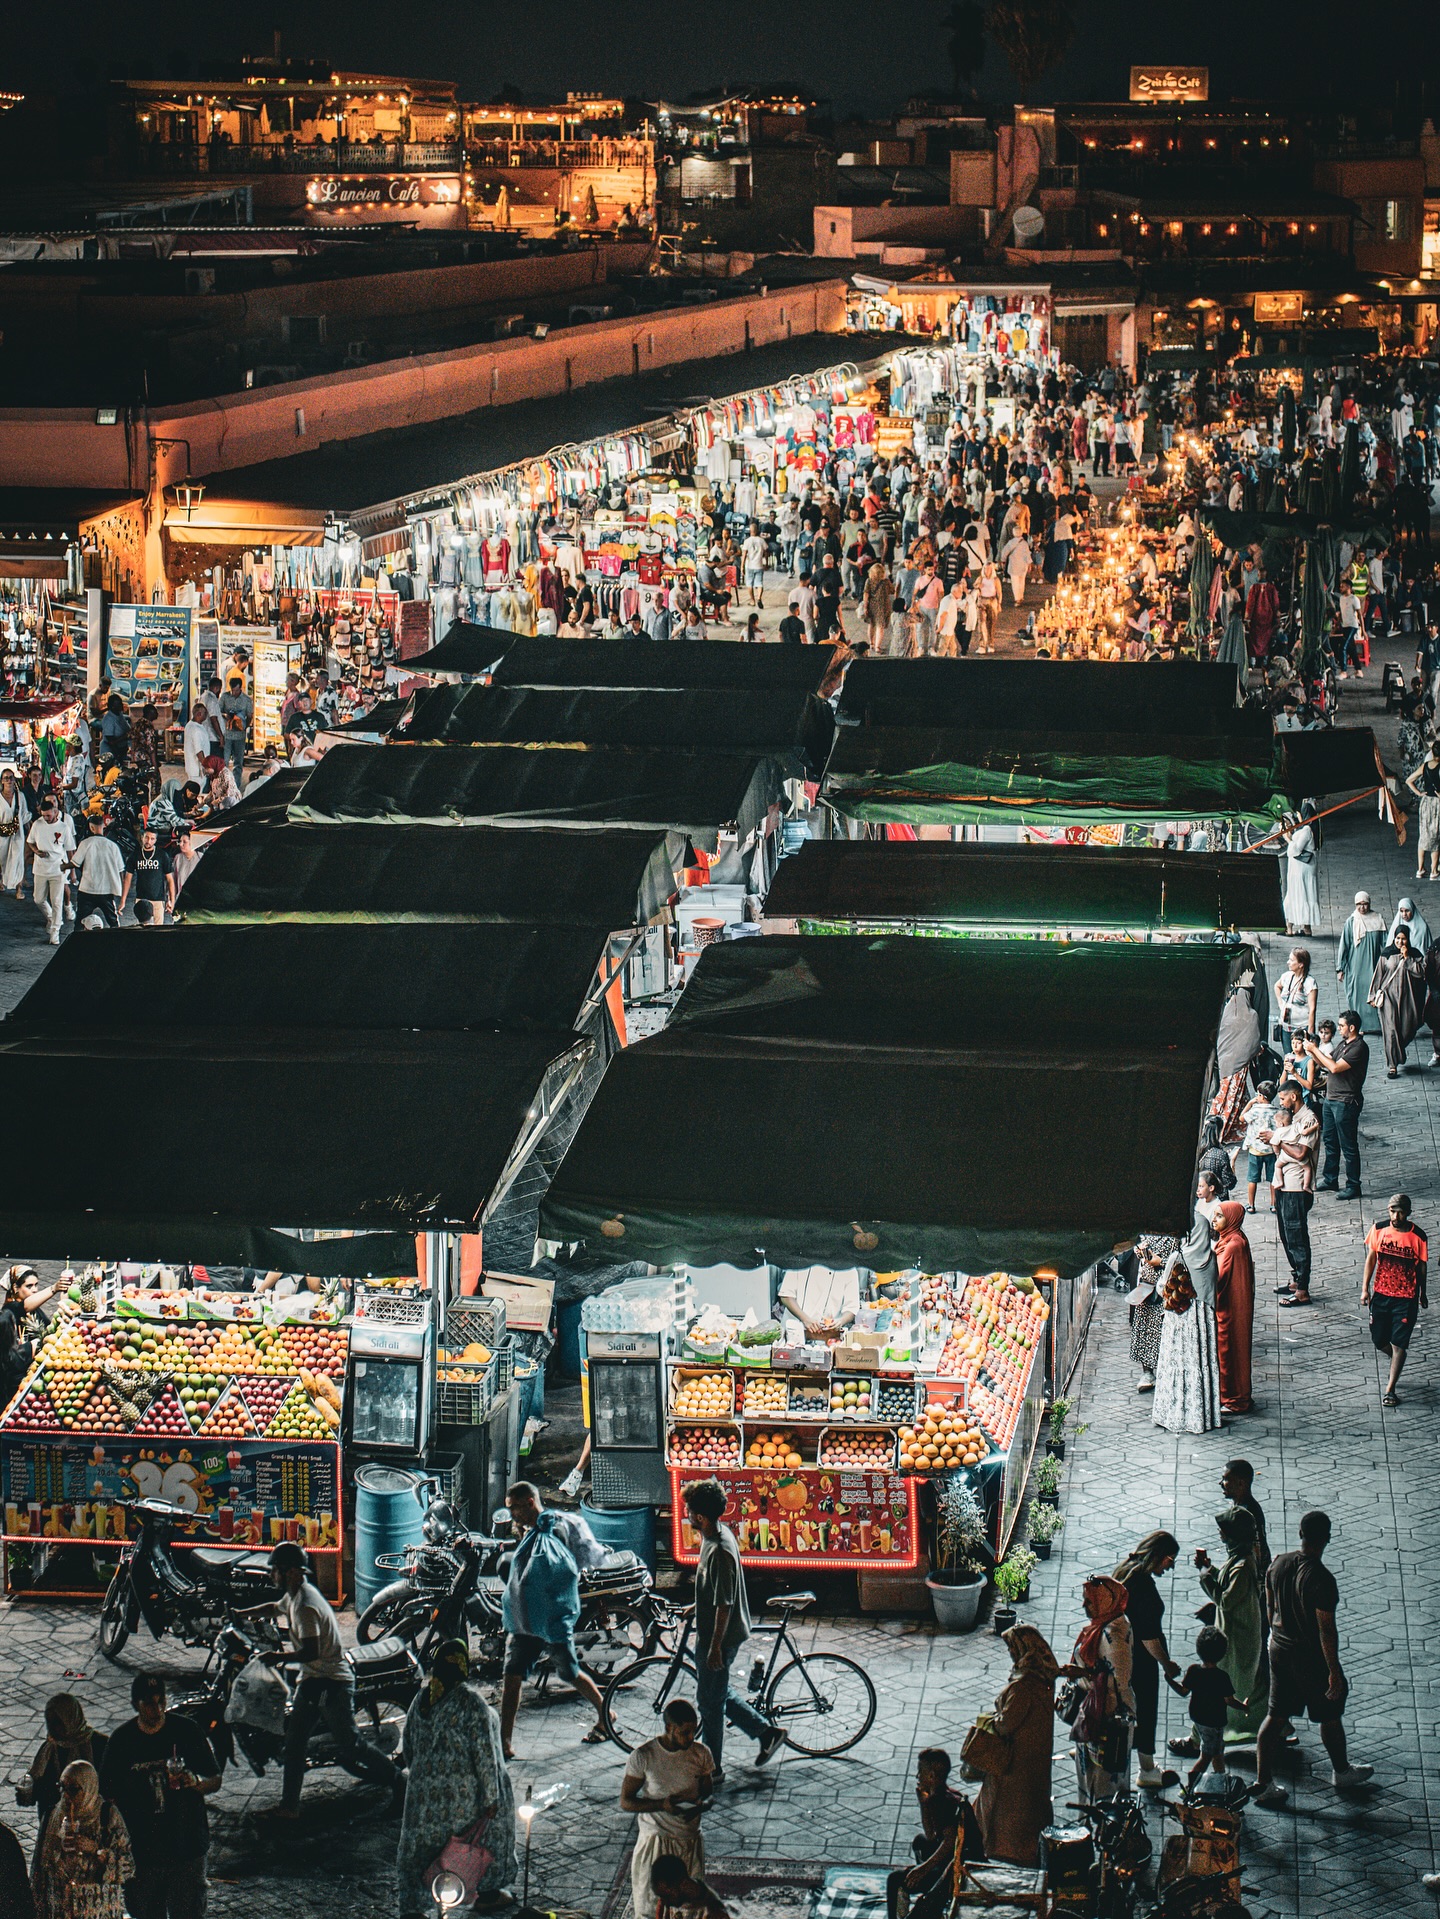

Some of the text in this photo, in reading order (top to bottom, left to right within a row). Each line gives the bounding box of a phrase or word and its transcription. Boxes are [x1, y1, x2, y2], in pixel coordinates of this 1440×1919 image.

[1178, 76, 1200, 88] Café
[573, 173, 602, 182] Terrasse
[321, 181, 420, 201] L'ancien Café
[645, 592, 652, 603] 9
[138, 611, 155, 619] Enjoy
[1076, 831, 1088, 842] 41
[137, 859, 159, 868] HUGO
[370, 1338, 399, 1350] Sidi ali
[607, 1341, 637, 1351] Sidi ali
